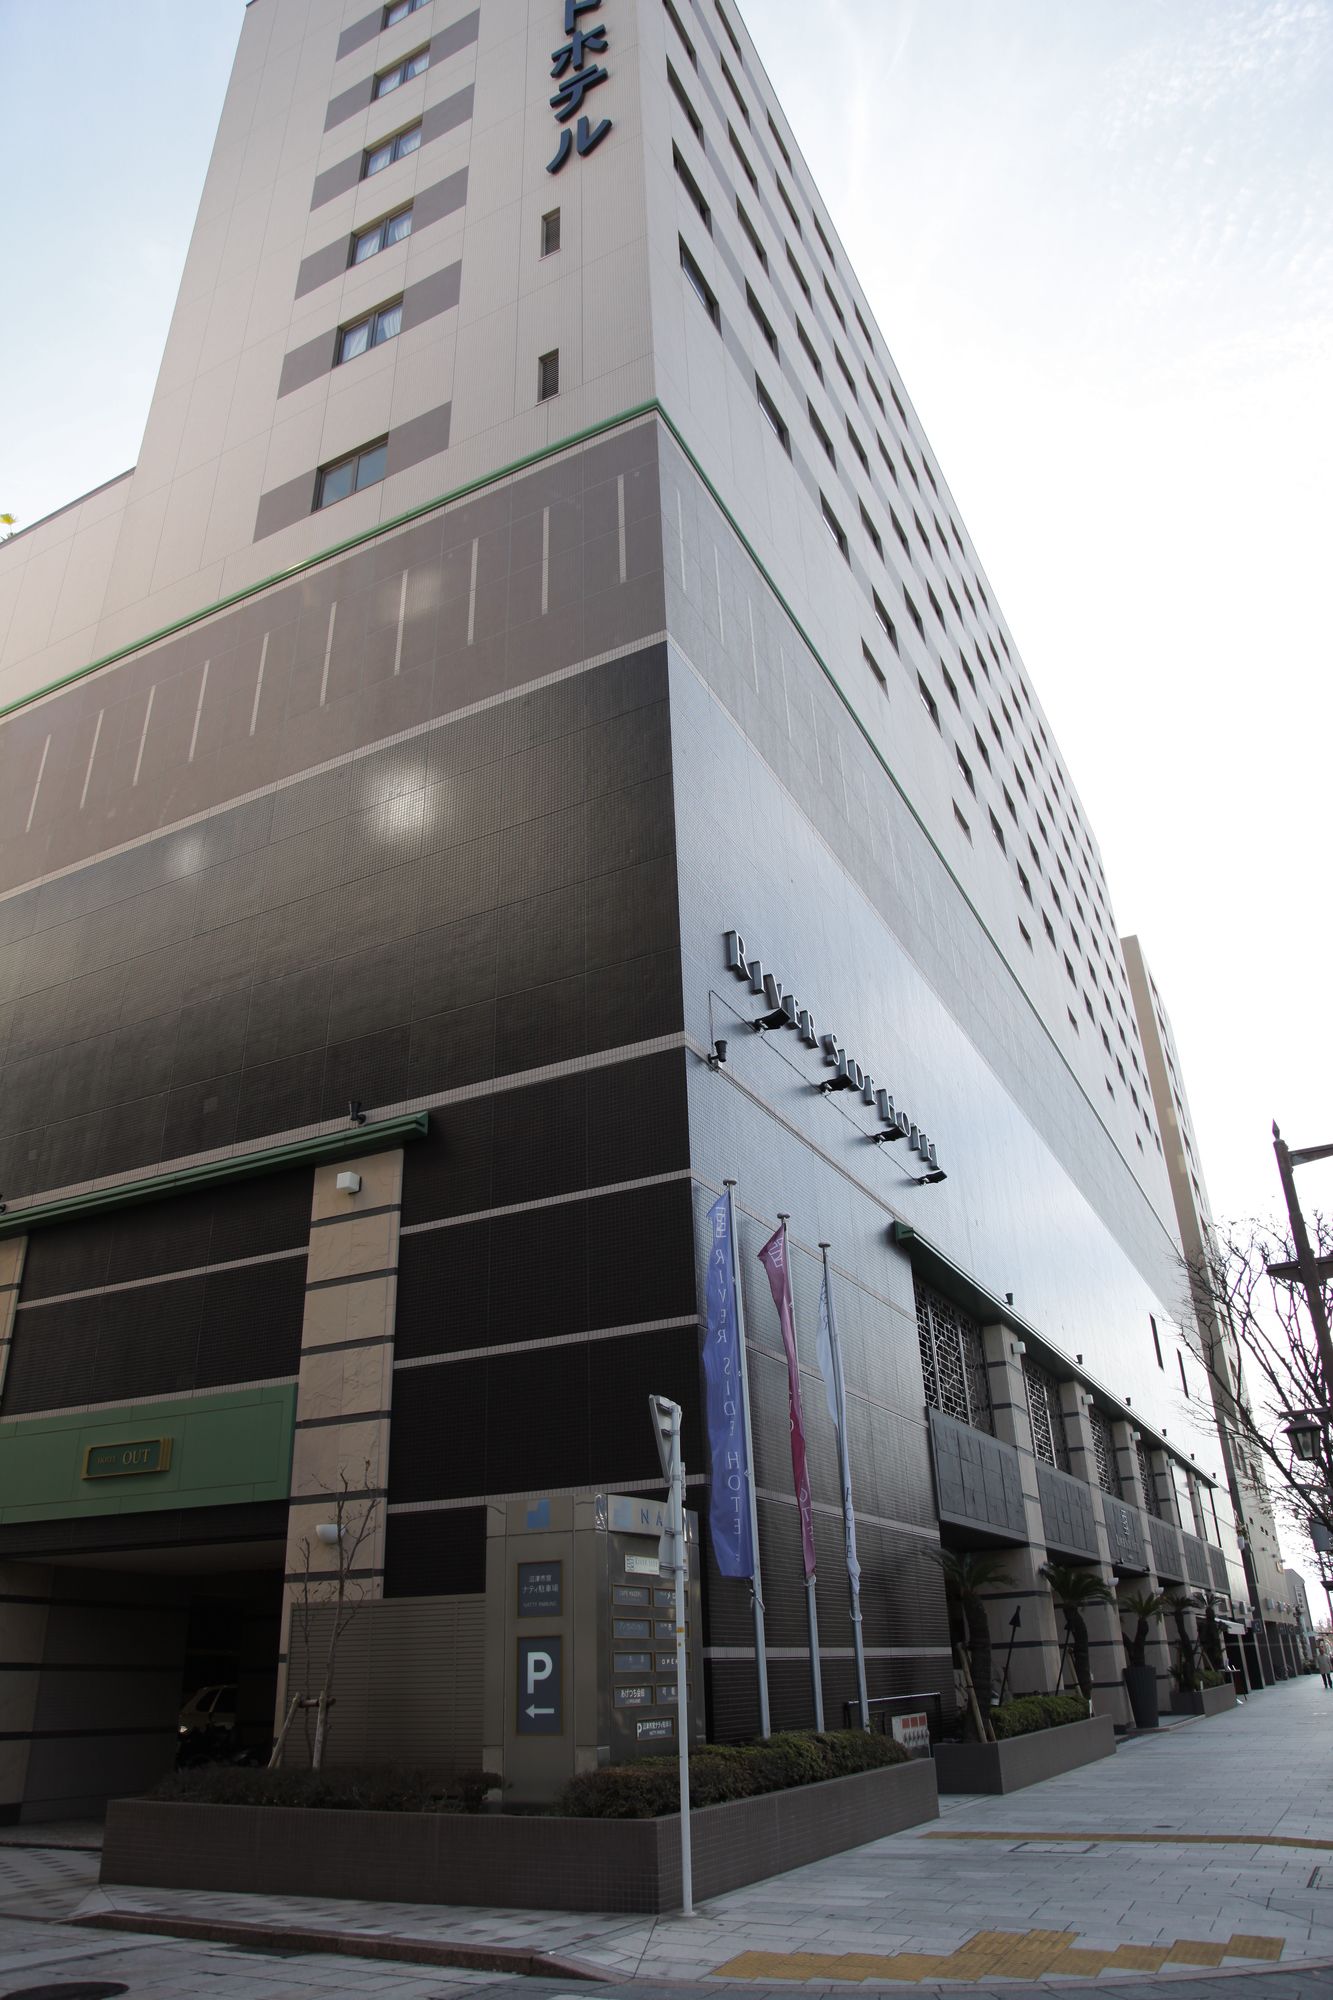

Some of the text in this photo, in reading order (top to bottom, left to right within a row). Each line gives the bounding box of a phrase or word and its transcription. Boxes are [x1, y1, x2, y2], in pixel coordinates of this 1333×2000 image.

[724, 929, 942, 1171] RIVER SIDE HOTEL
[122, 1447, 151, 1465] OUT
[527, 1651, 553, 1694] P
[636, 1722, 643, 1741] P
